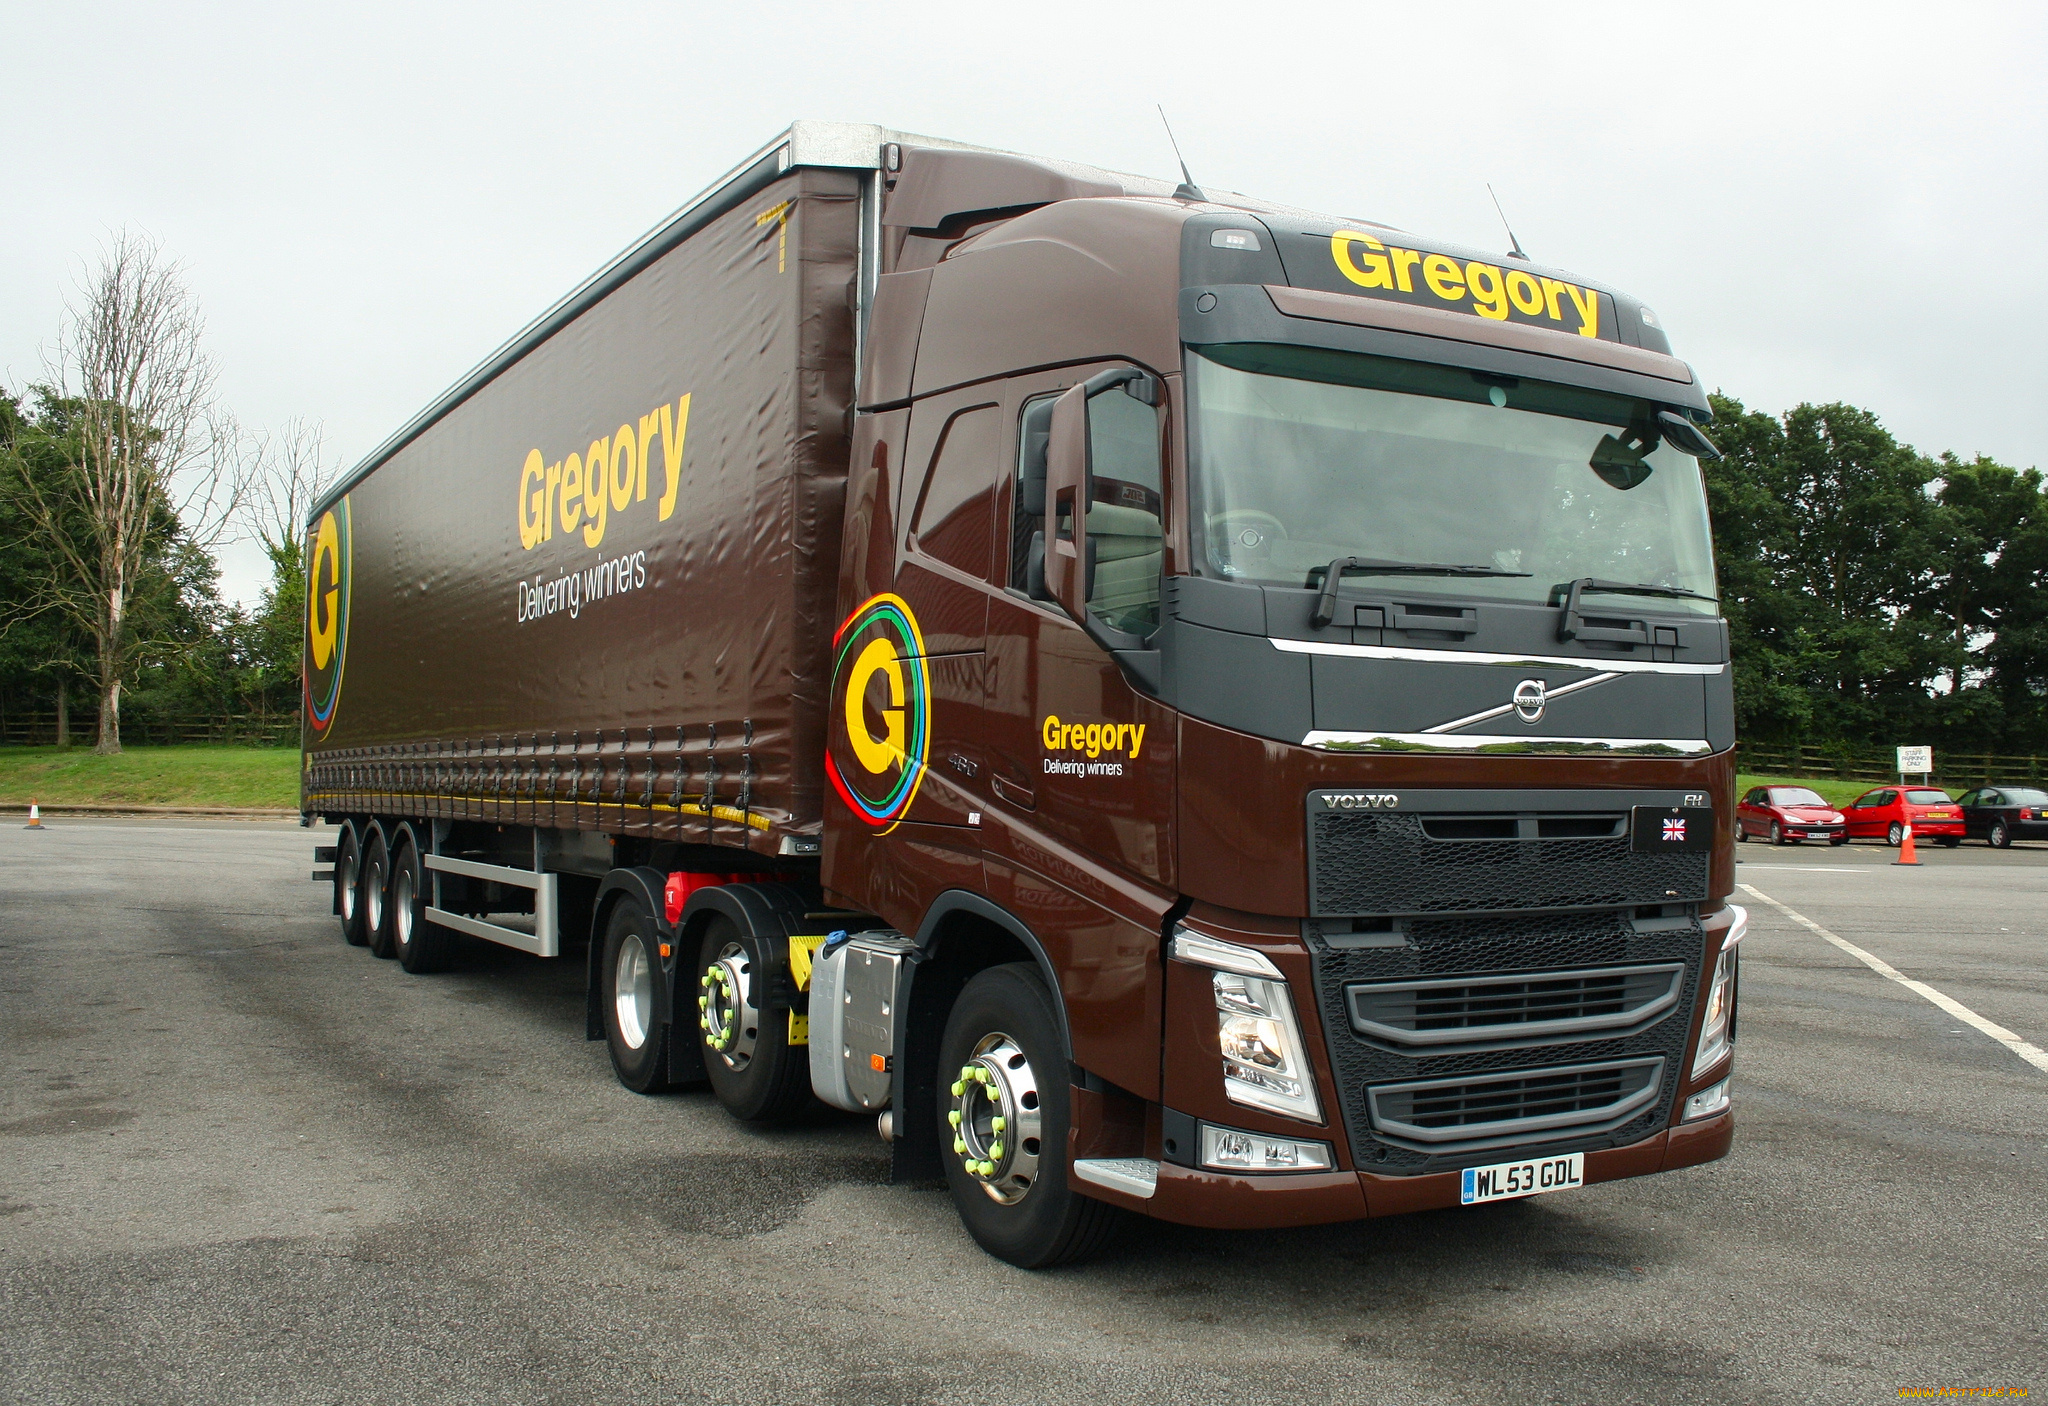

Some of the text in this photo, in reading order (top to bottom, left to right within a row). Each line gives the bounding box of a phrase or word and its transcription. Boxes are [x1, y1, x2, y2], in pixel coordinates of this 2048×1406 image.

[1331, 229, 1598, 339] Gregory
[518, 392, 691, 550] Gregory
[310, 511, 339, 670] G
[518, 550, 645, 623] Delivering winners
[845, 637, 905, 775] G
[1516, 698, 1544, 706] VOLVO
[1042, 714, 1146, 759] Gregory
[1043, 758, 1123, 778] Delivering winners
[1321, 794, 1399, 809] VOLVO
[1683, 794, 1703, 807] FH
[1463, 1191, 1474, 1200] GB
[1477, 1158, 1580, 1198] WL53 GDL
